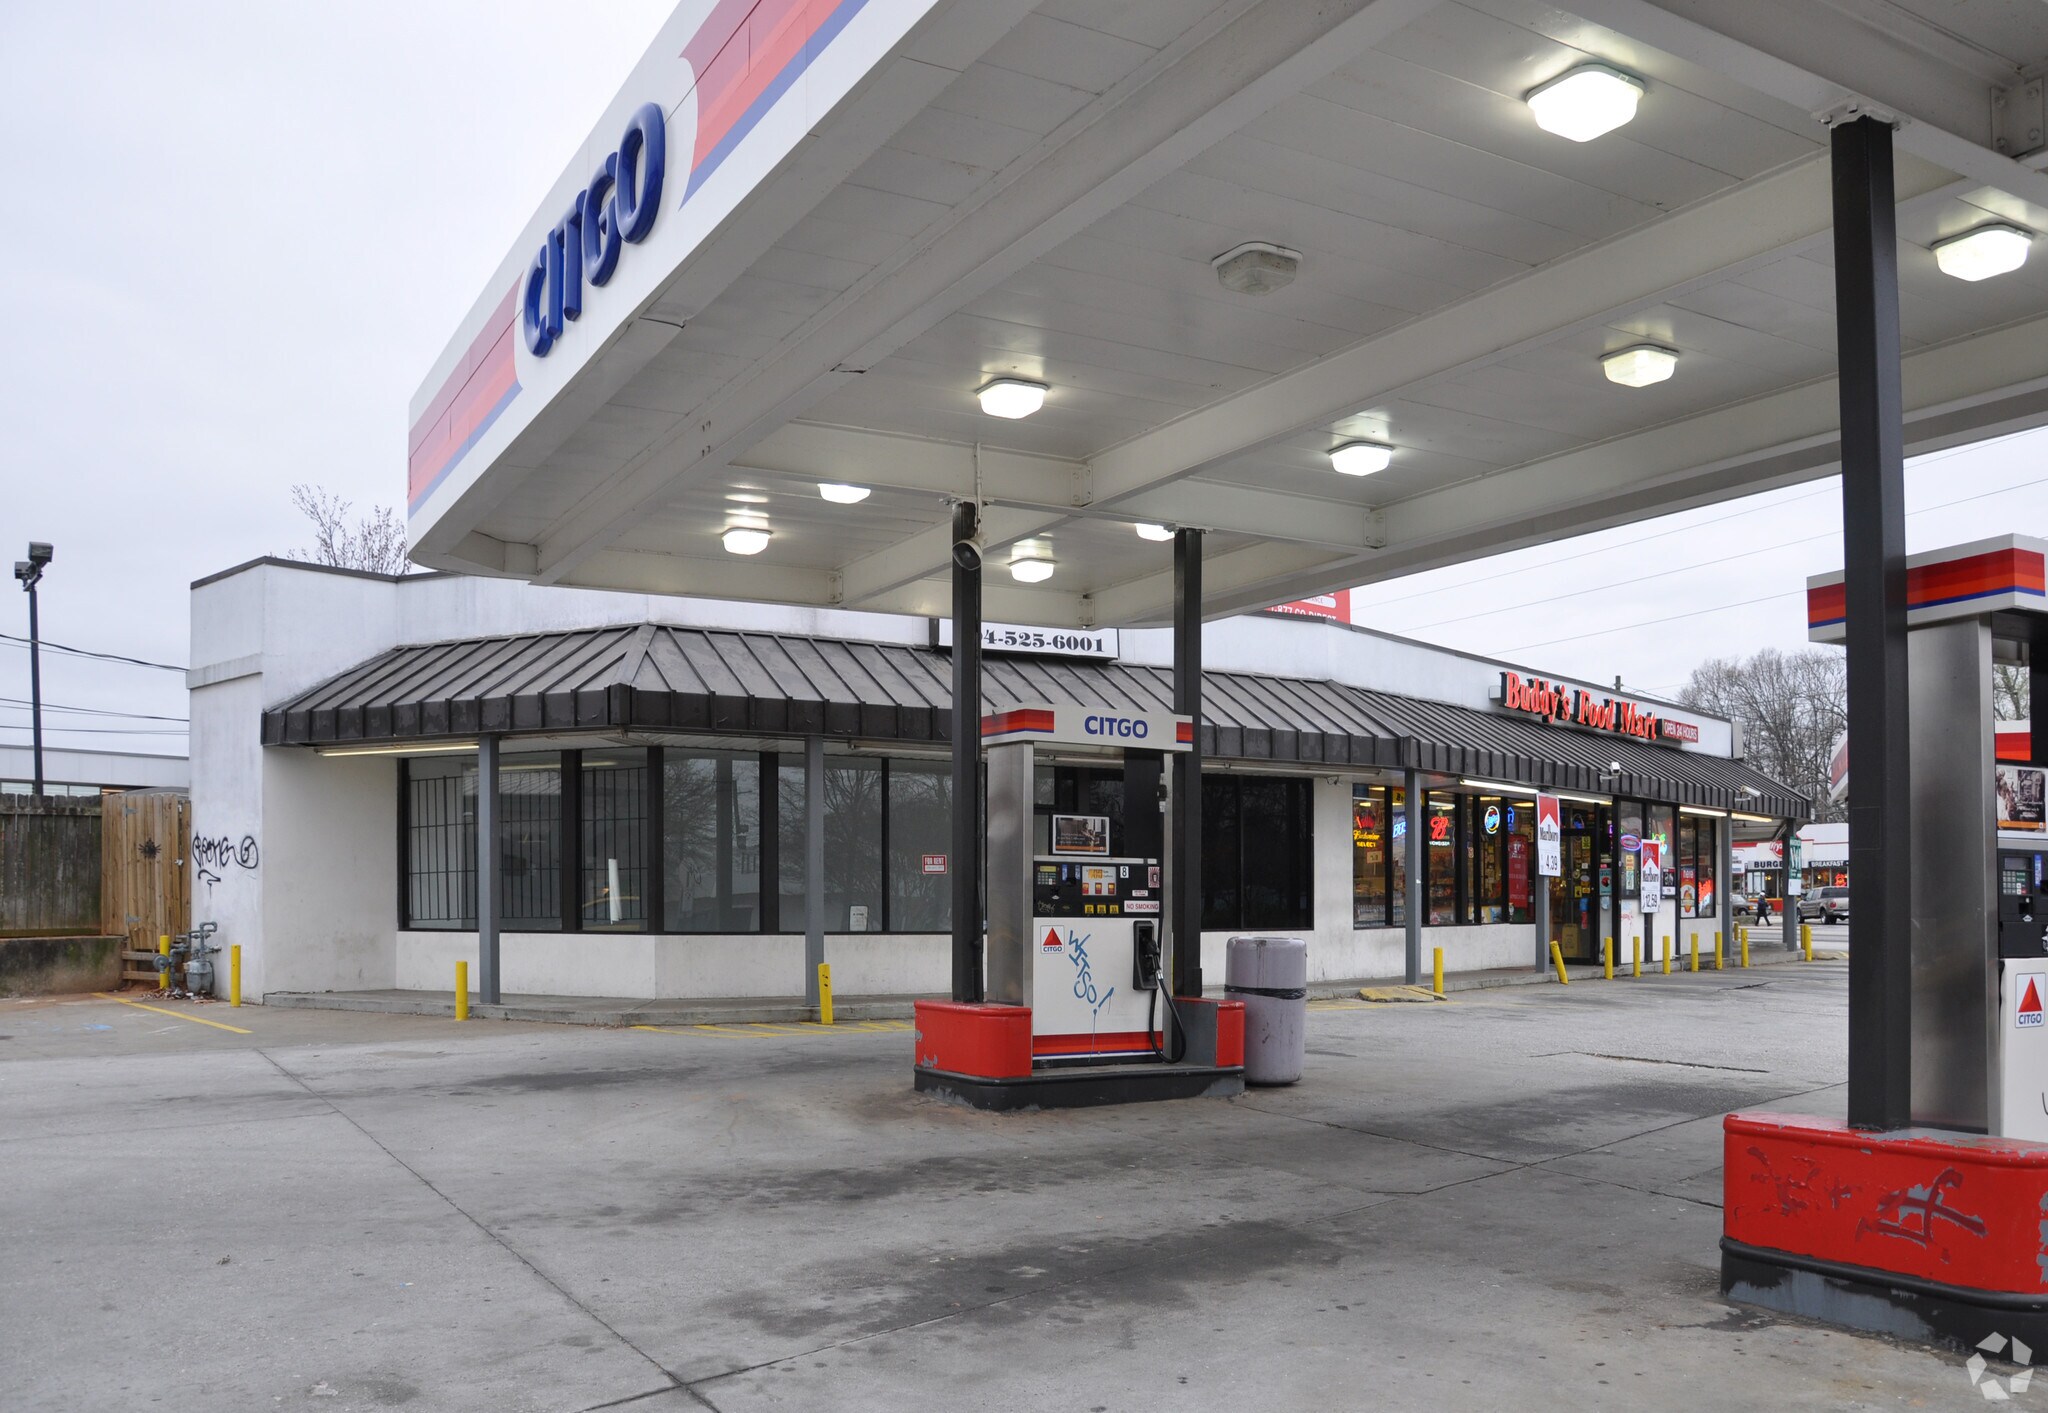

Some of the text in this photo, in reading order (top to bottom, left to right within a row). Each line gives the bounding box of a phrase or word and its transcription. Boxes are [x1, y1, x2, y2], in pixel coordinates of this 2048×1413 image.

[523, 102, 665, 357] CITGO
[981, 628, 1104, 652] 4-525-6001
[1504, 671, 1657, 741] Buddy's Food Mart
[1084, 715, 1149, 739] CITGO
[1664, 722, 1676, 736] OPEN
[1683, 724, 1698, 740] HOURS
[924, 857, 932, 865] FOR
[1122, 866, 1127, 877] 8
[2018, 1013, 2042, 1024] CITGO
